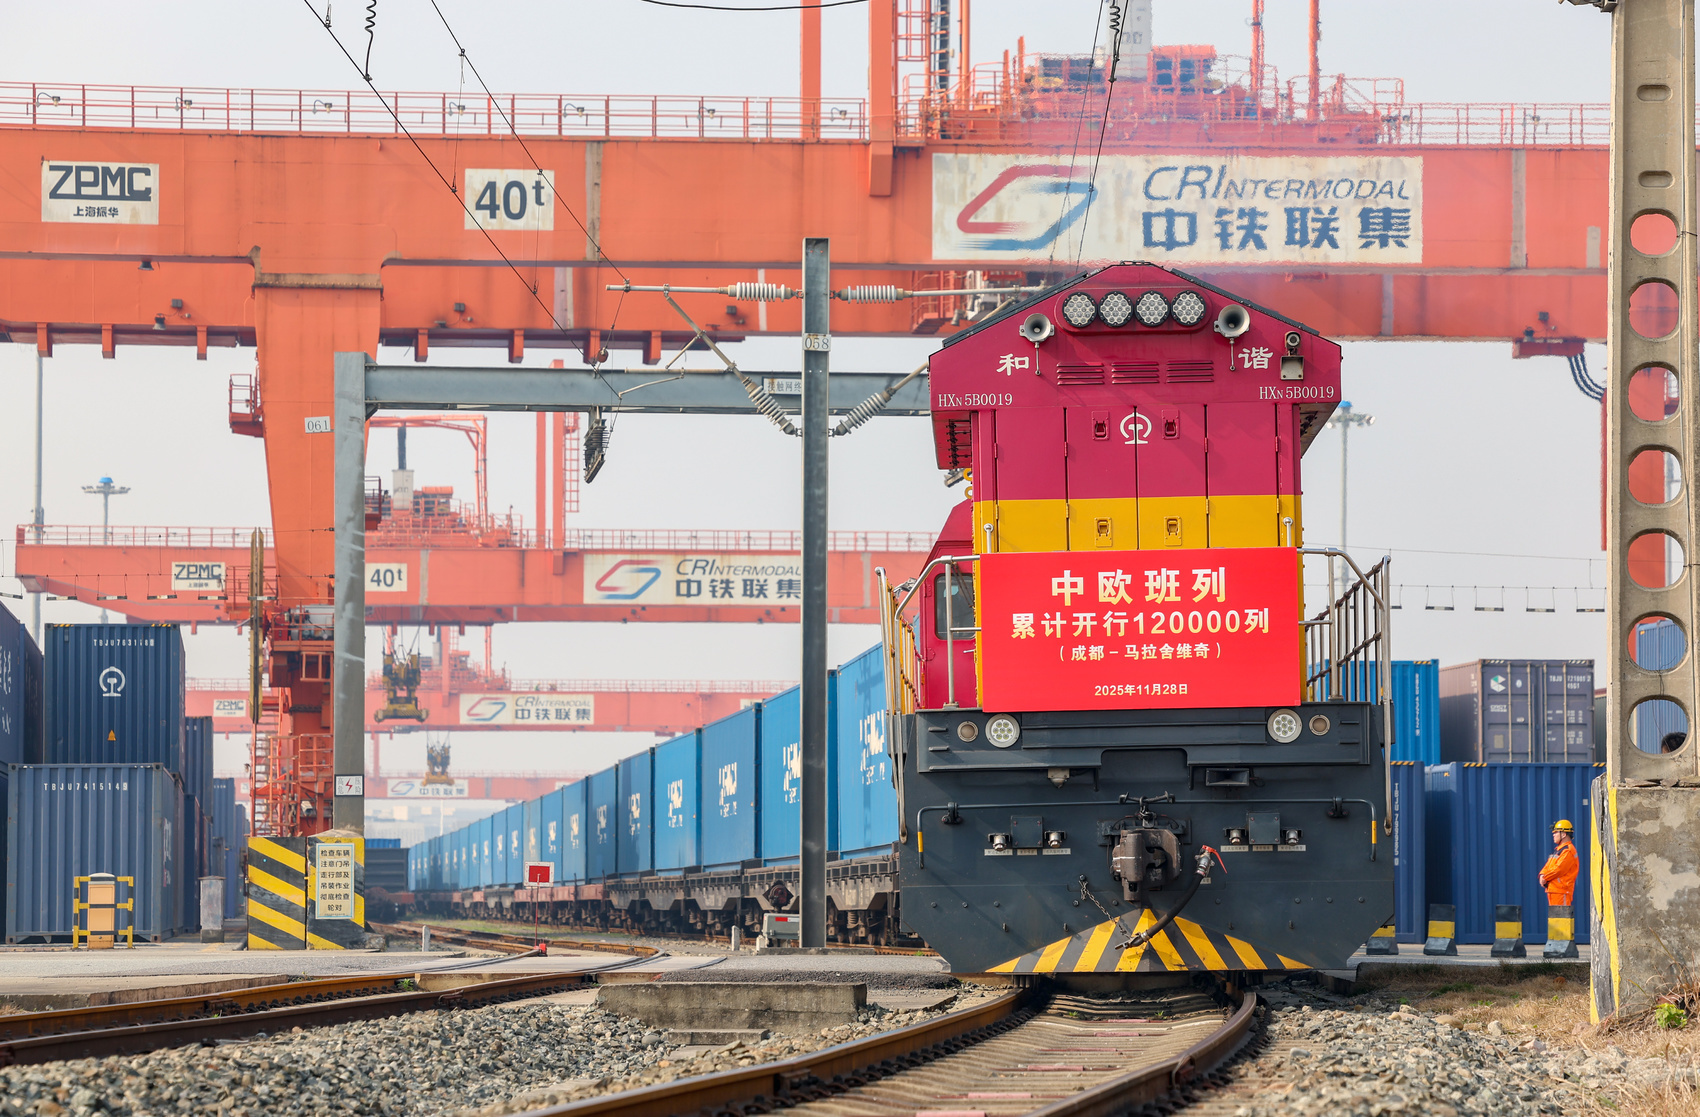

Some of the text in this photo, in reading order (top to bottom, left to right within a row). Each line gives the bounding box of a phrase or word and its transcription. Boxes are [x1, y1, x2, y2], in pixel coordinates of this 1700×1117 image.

[48, 165, 152, 202] ZPMC
[73, 206, 119, 218] 上海振华
[1142, 206, 1411, 251] 中铁联集
[804, 337, 829, 350] 058
[996, 346, 1273, 376] 和 谐
[307, 420, 329, 432] 061
[175, 564, 222, 580] ZPMC
[675, 578, 802, 600] 中铁联集
[1051, 566, 1227, 607] 中欧班列
[1011, 607, 1270, 640] 累计开行120000列
[1094, 683, 1189, 697] 2025年11月28日
[320, 849, 350, 857] 检查车辆
[320, 860, 350, 868] 注意门吊
[320, 871, 350, 879] 走行部及
[320, 882, 350, 890] 吊装作业
[320, 893, 350, 901] 彻底检查
[327, 904, 343, 912] 轮对
